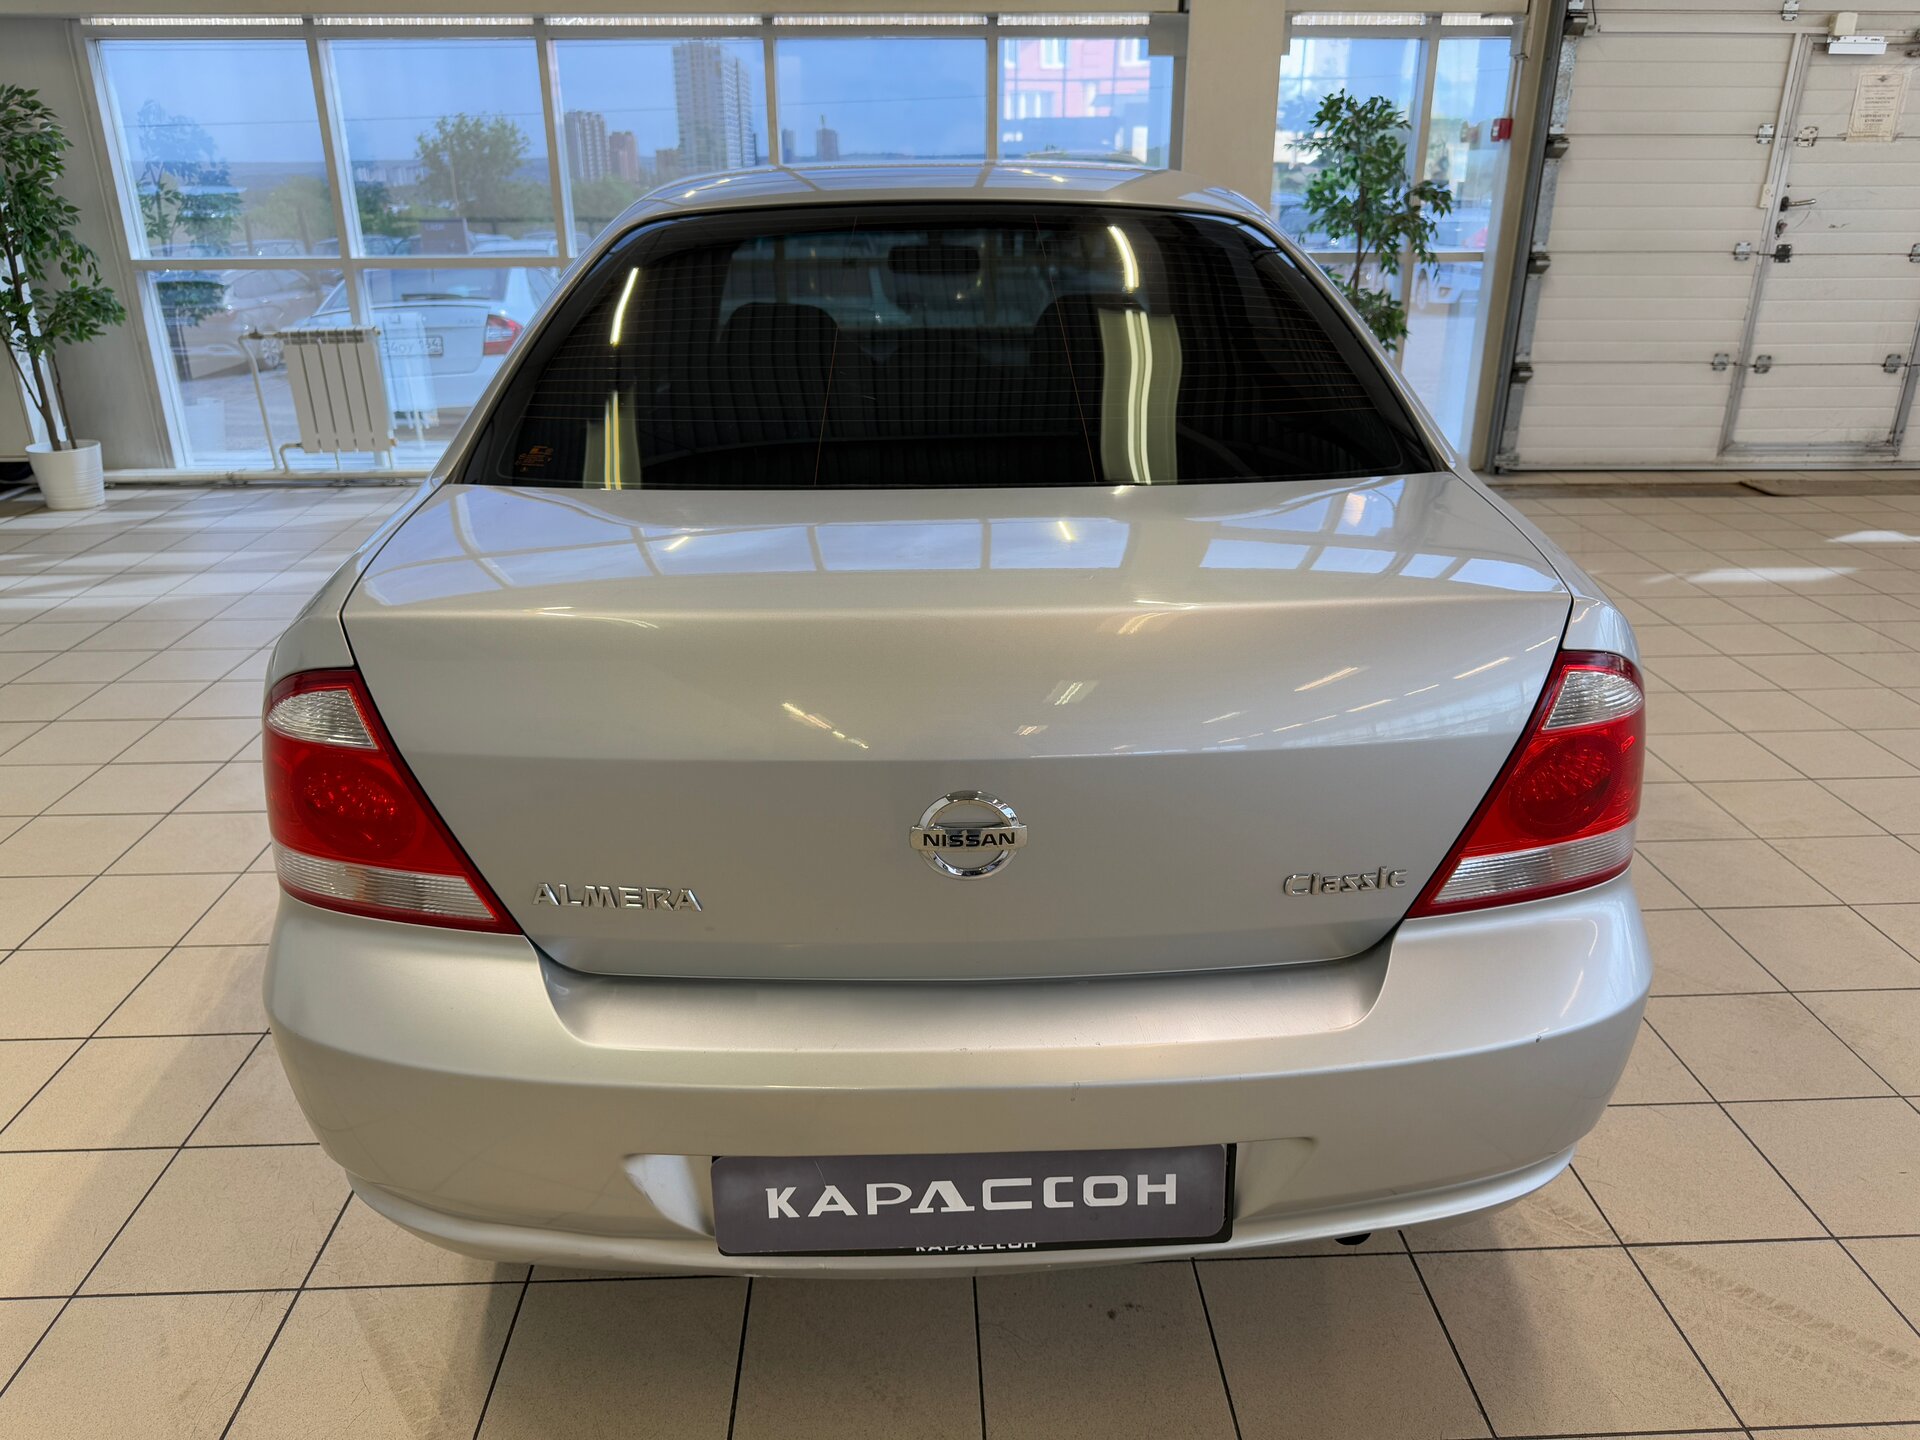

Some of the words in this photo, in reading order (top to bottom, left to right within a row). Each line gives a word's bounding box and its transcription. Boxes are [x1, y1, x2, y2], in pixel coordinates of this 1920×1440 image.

[923, 832, 1015, 847] NISSAN
[1284, 866, 1407, 896] Classic
[532, 882, 702, 912] ALMERA
[765, 1173, 1177, 1219] КАРАССОН
